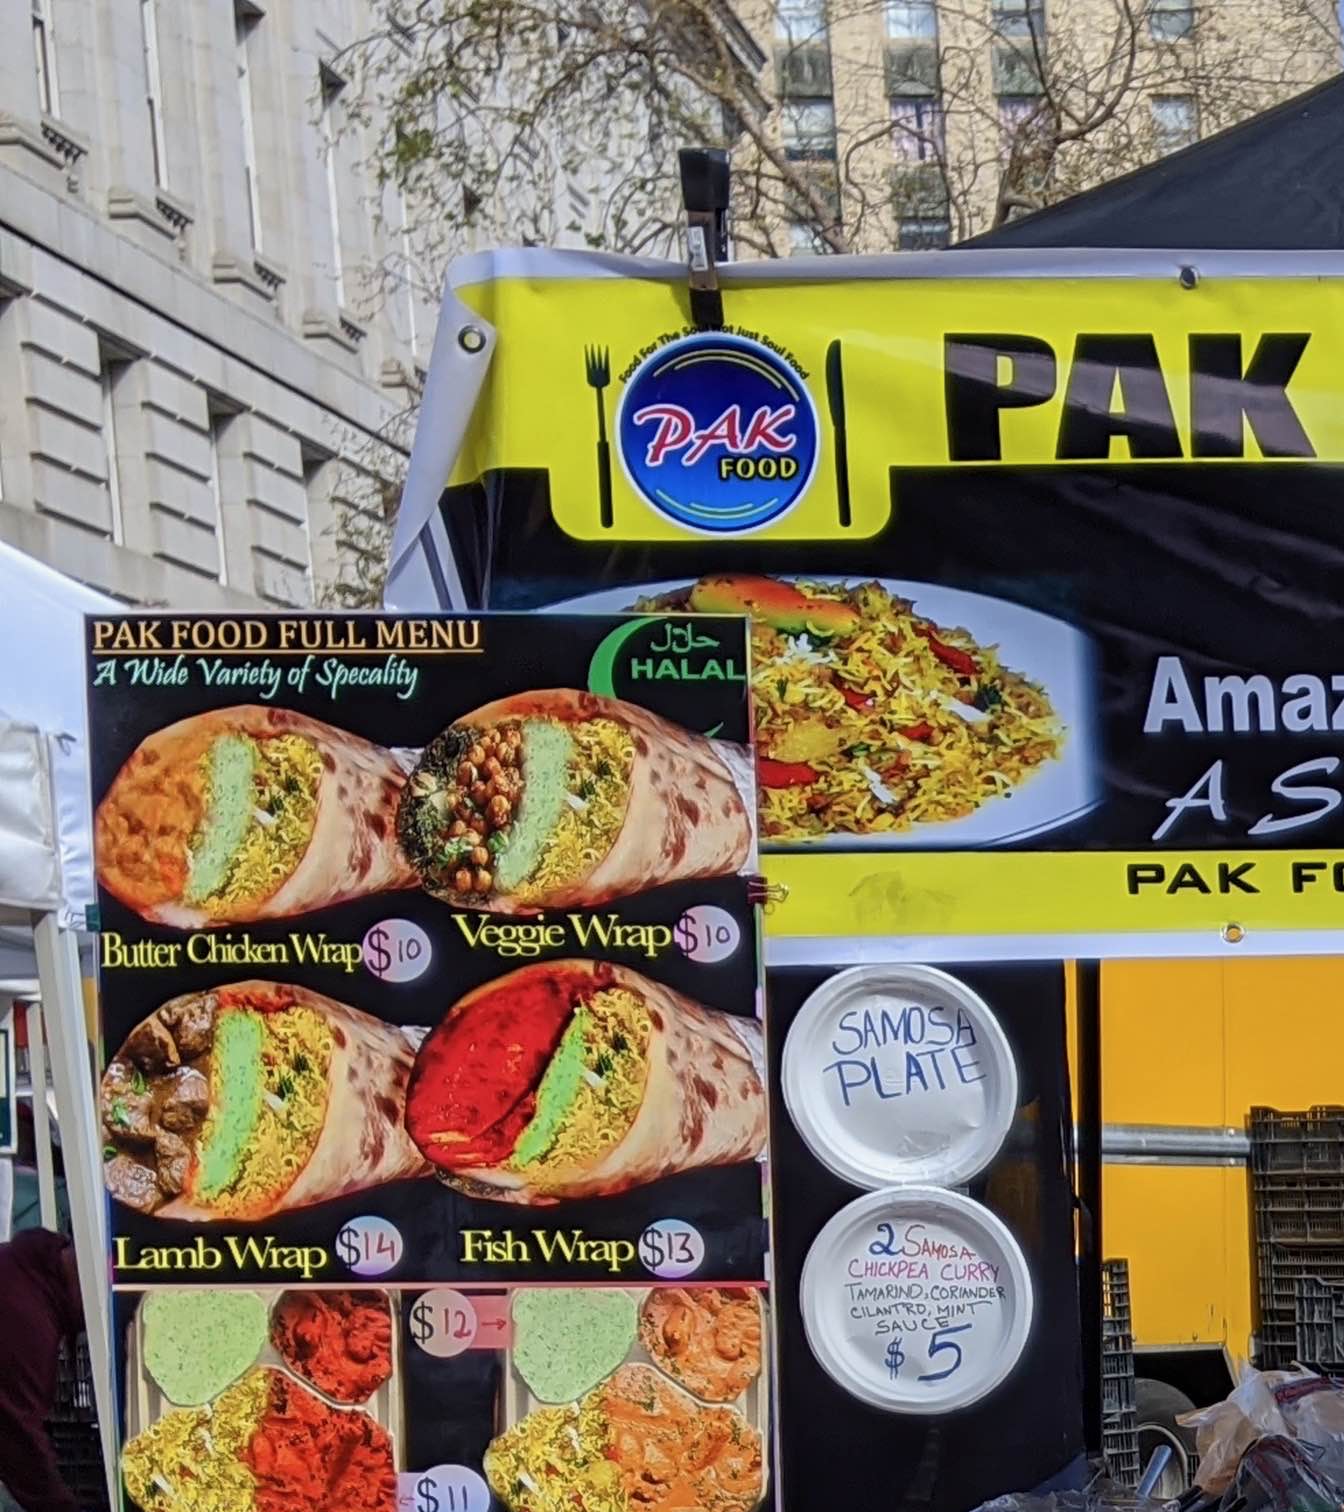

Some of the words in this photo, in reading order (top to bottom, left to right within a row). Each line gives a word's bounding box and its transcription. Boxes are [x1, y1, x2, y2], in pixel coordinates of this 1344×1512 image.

[658, 332, 680, 345] The
[737, 326, 759, 341] Just
[761, 335, 785, 354] Soul
[785, 352, 810, 380] Food
[943, 331, 1318, 462] PAK
[633, 404, 796, 466] PAK
[720, 456, 797, 479] FOOD
[93, 620, 161, 650] PAK
[172, 620, 268, 649] FOOD
[278, 619, 365, 649] FULL
[376, 618, 482, 648] MENU
[93, 658, 117, 686] A
[124, 653, 189, 687] Wide
[196, 654, 283, 699] Variety
[289, 652, 311, 688] of
[315, 652, 420, 699] Specality
[632, 657, 747, 682] HALAL
[1151, 763, 1226, 839] A
[1127, 860, 1260, 894] PAK
[101, 931, 180, 969] Butter
[187, 930, 288, 965] Chicken
[290, 932, 363, 975] Wrap
[451, 913, 566, 959] Veggie
[576, 913, 672, 957] Wrap
[832, 1004, 976, 1055] SAMOSA
[822, 1044, 987, 1106] PLATE
[113, 1236, 222, 1270] Lamb
[226, 1236, 327, 1278] Wrap
[337, 1227, 397, 1270] $14
[459, 1228, 532, 1263] Fish
[534, 1231, 635, 1272] Wrap
[869, 1223, 901, 1257] 2
[848, 1258, 929, 1279] CHICKPEA
[940, 1261, 999, 1283] CURRY
